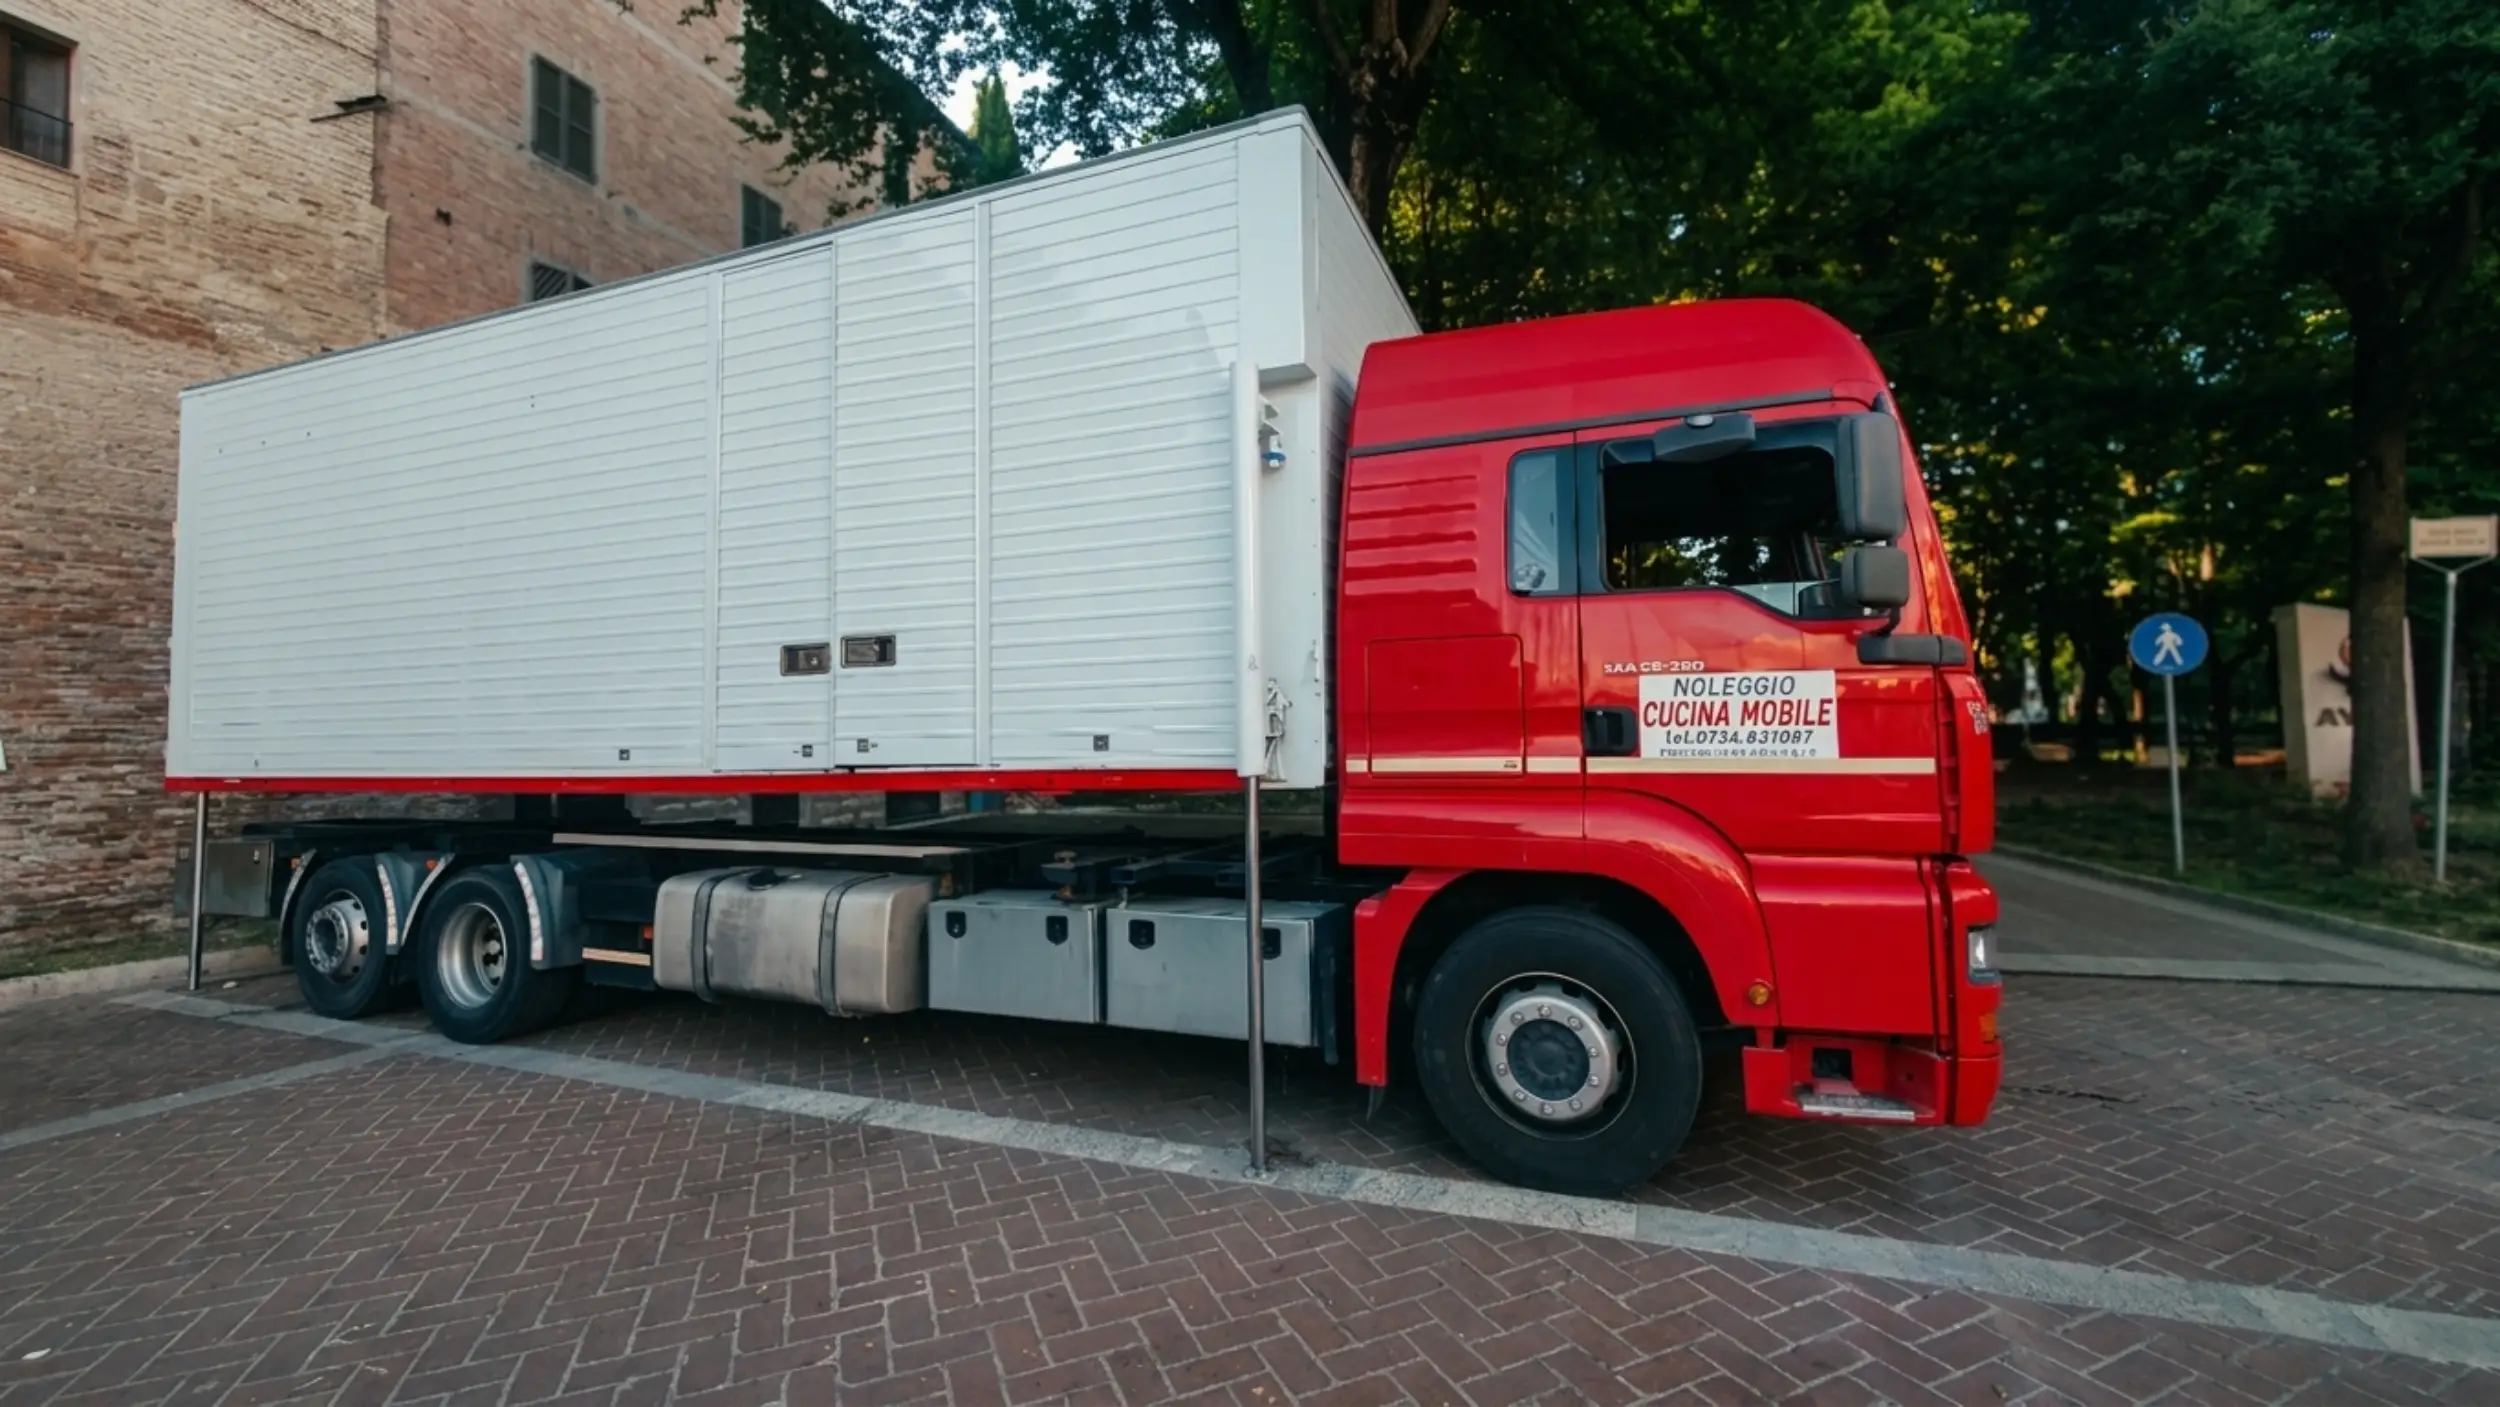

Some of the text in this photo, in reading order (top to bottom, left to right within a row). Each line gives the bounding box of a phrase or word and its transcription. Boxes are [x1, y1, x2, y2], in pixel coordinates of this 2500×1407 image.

[1673, 676, 1796, 697] NOLEGGIO
[1643, 698, 1833, 728] CUCINA MOBILE
[2315, 707, 2355, 727] AV
